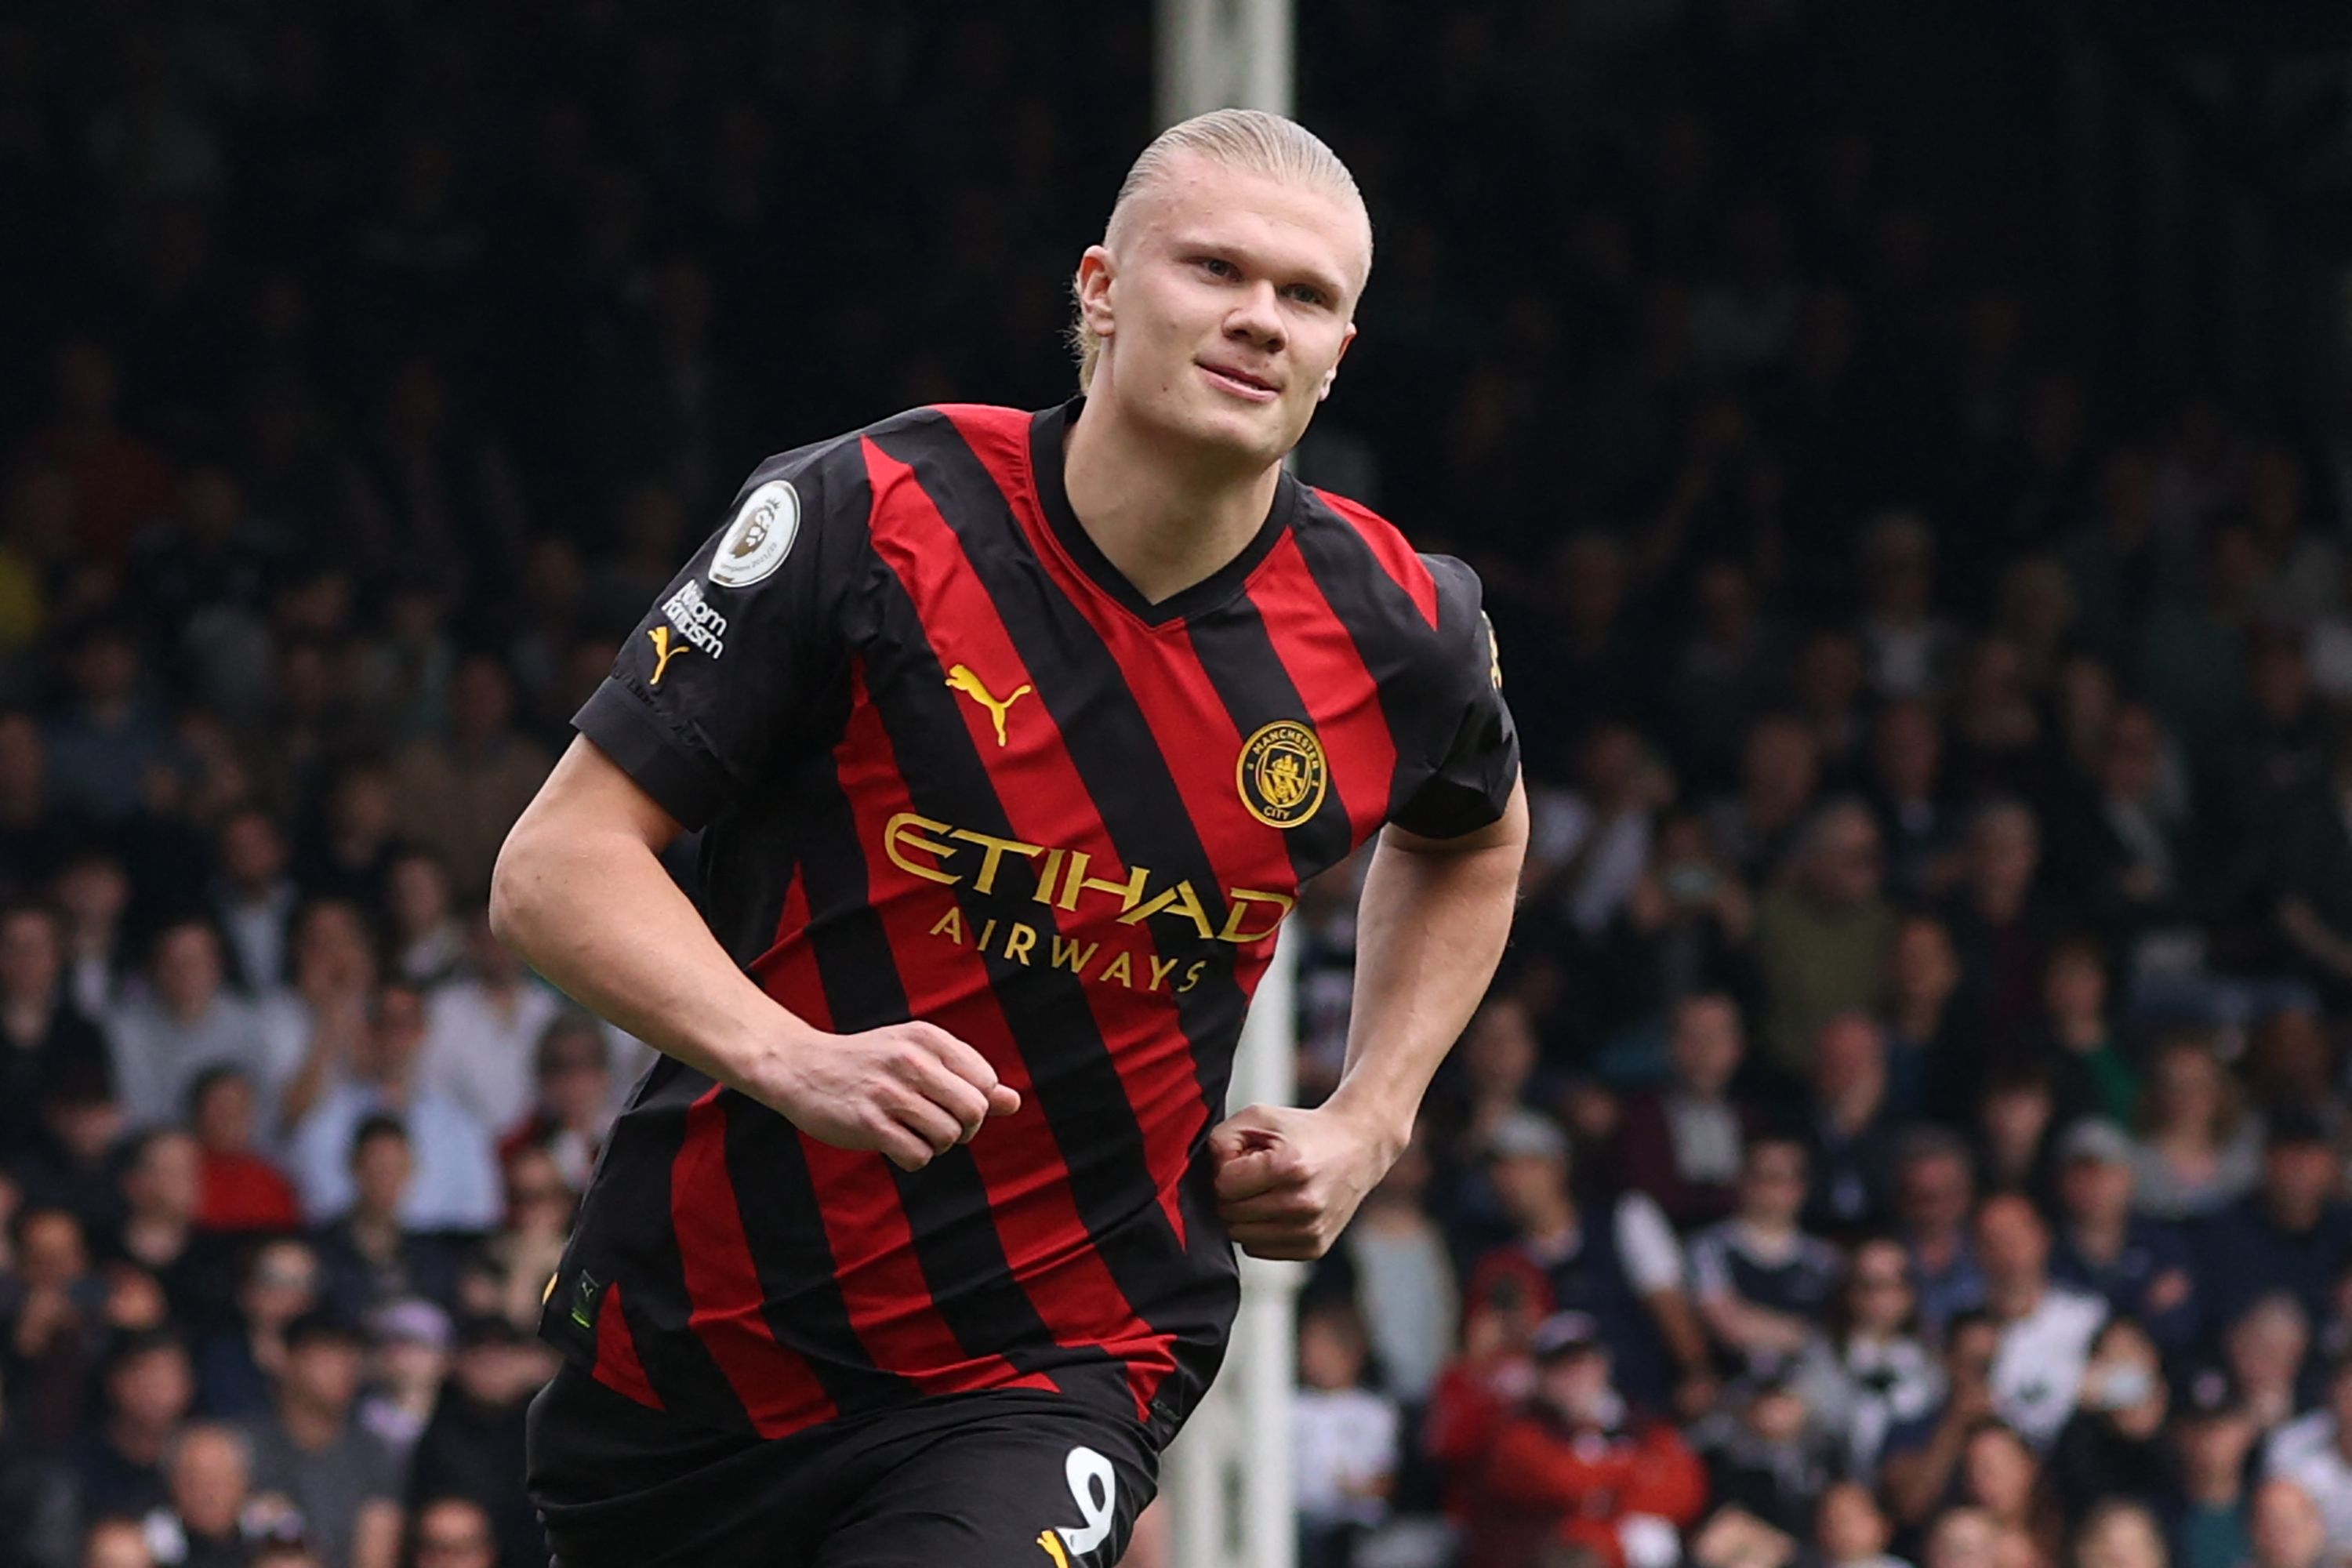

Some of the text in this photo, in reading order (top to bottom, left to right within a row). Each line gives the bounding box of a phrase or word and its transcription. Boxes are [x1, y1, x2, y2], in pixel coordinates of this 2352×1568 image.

[1253, 728, 1320, 769] MANCHESTER
[1263, 805, 1291, 820] CITY
[884, 812, 1295, 942] ETIHAD
[930, 906, 1207, 993] AIRWAYS
[1055, 1445, 1116, 1556] 9
